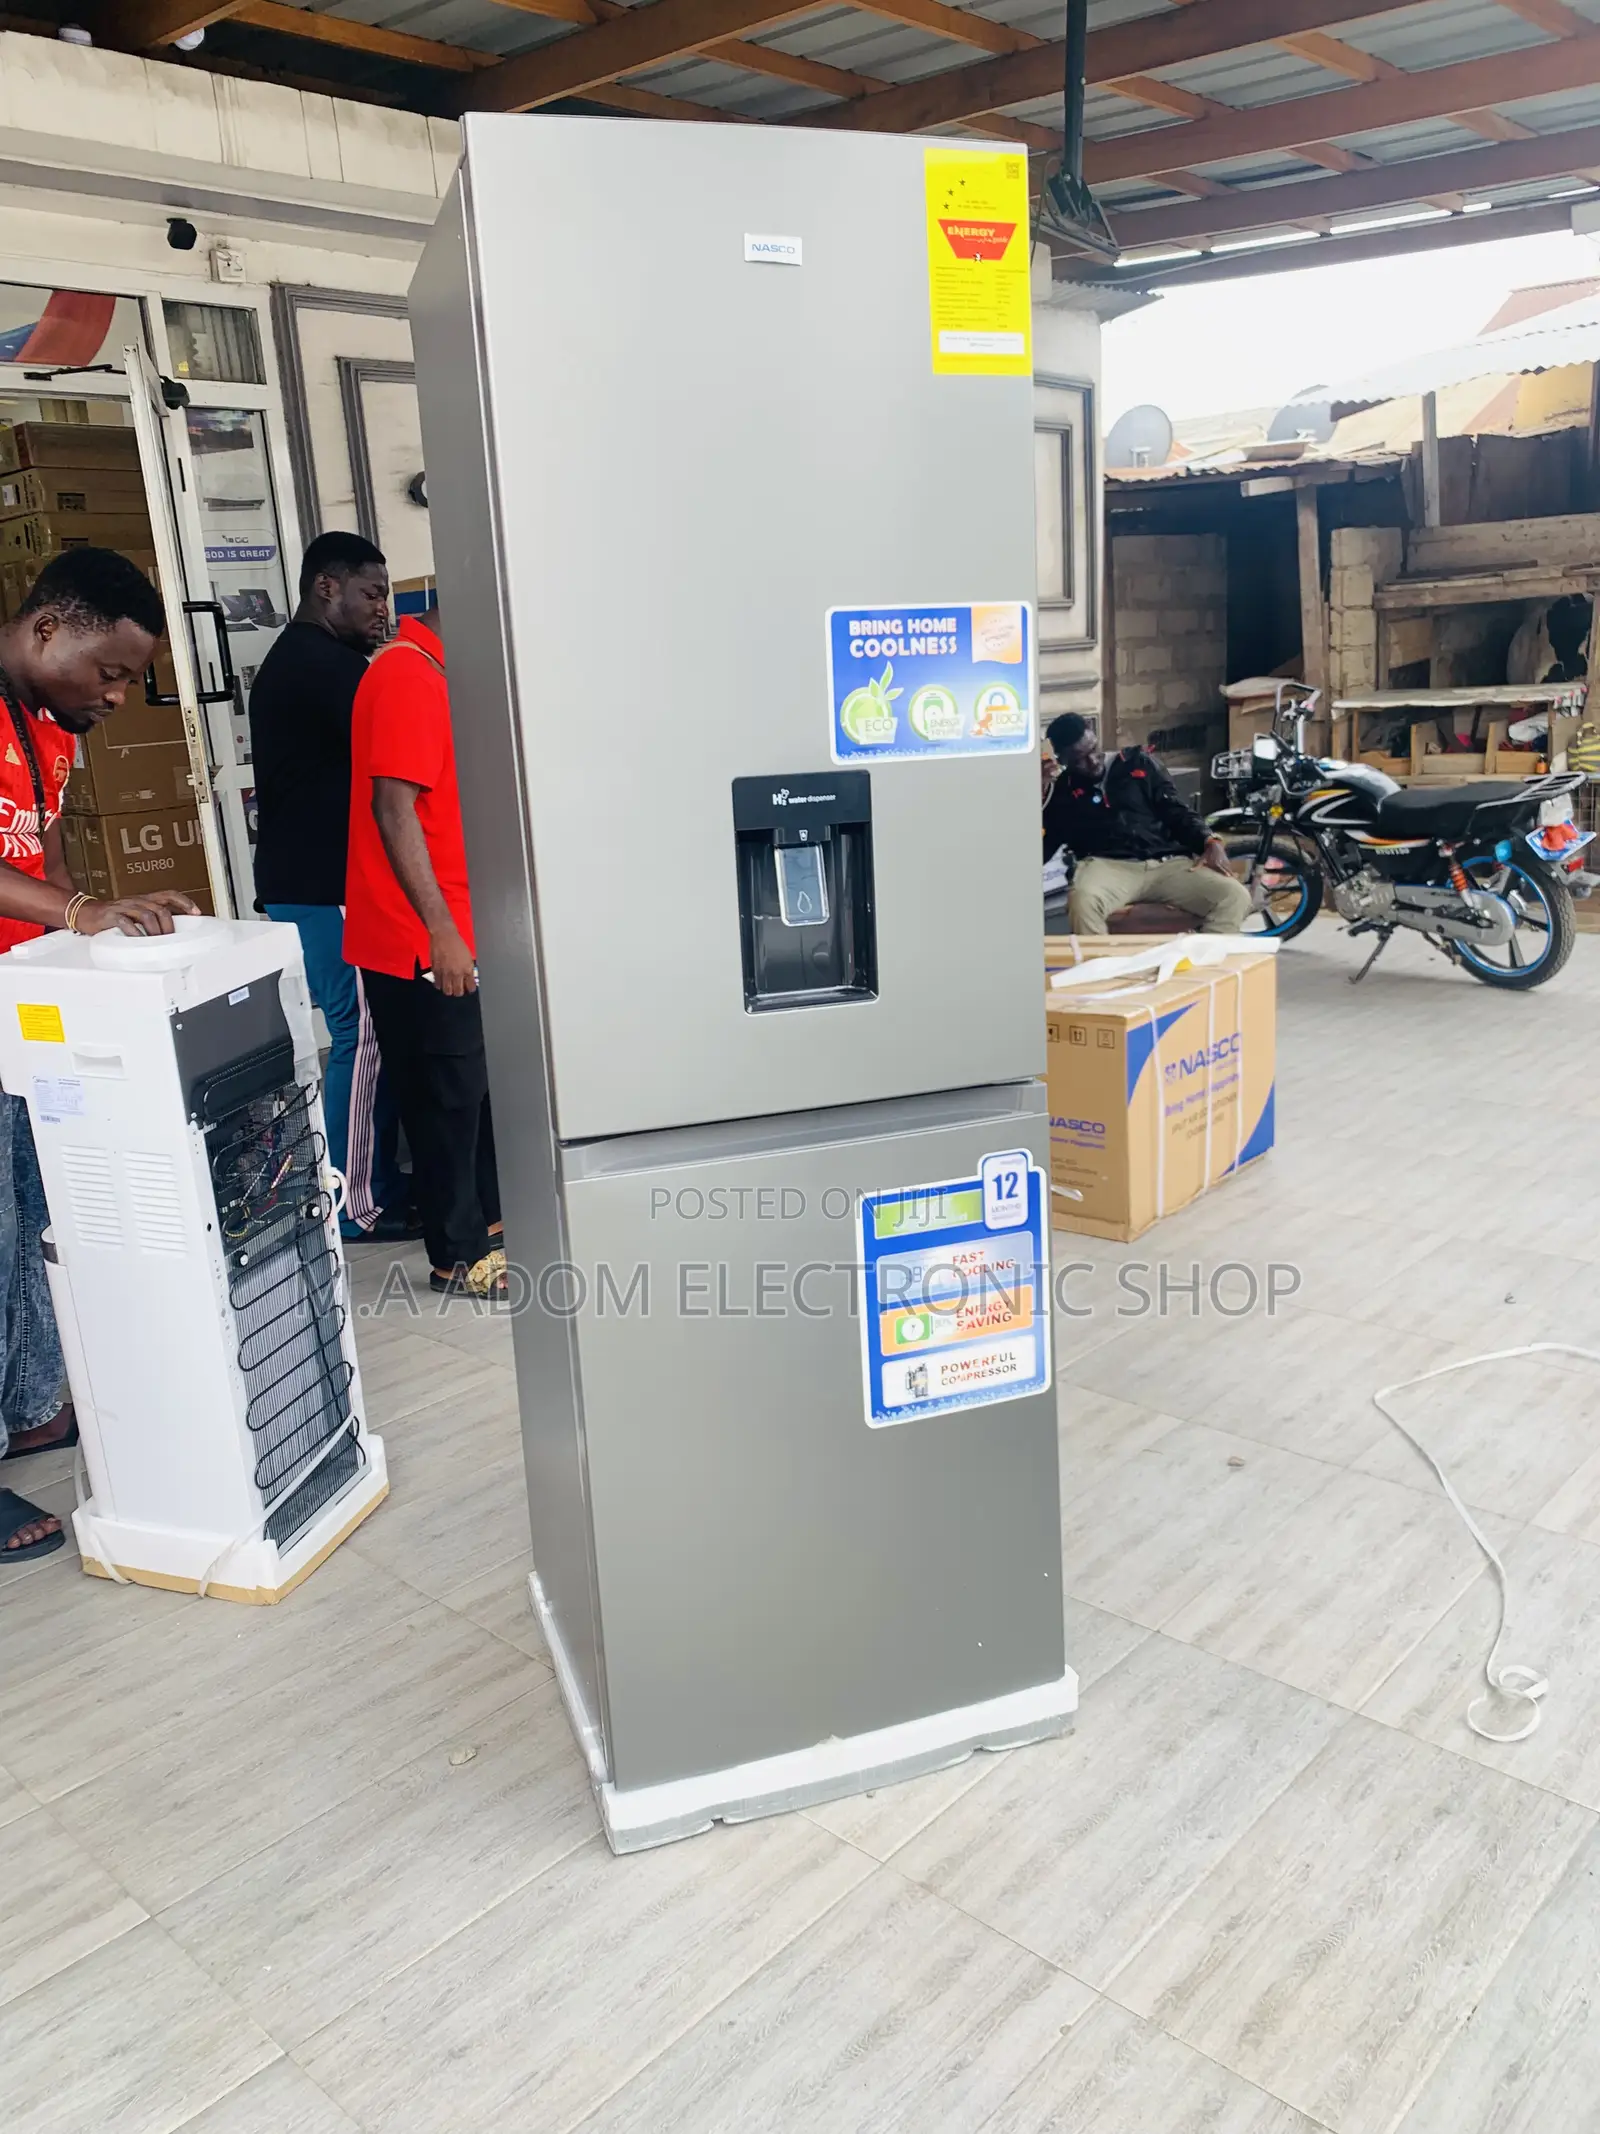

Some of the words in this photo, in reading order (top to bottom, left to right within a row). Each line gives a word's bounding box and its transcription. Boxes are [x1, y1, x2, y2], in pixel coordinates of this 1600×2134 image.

[947, 225, 996, 238] ENERGY
[751, 243, 796, 254] NASCO
[205, 550, 225, 559] GOD
[227, 550, 237, 558] IS
[239, 549, 271, 558] GREAT
[849, 619, 903, 636] BRING
[907, 617, 957, 634] HOME
[849, 636, 957, 658] COOLNESS
[865, 719, 893, 732] ECO
[120, 824, 163, 854] LG
[126, 857, 175, 874] 55UR80
[992, 1171, 1019, 1201] 12
[956, 1312, 1013, 1331] SAVING
[941, 1352, 1016, 1375] POWERFUL
[941, 1363, 1018, 1386] COMPRESSOR
